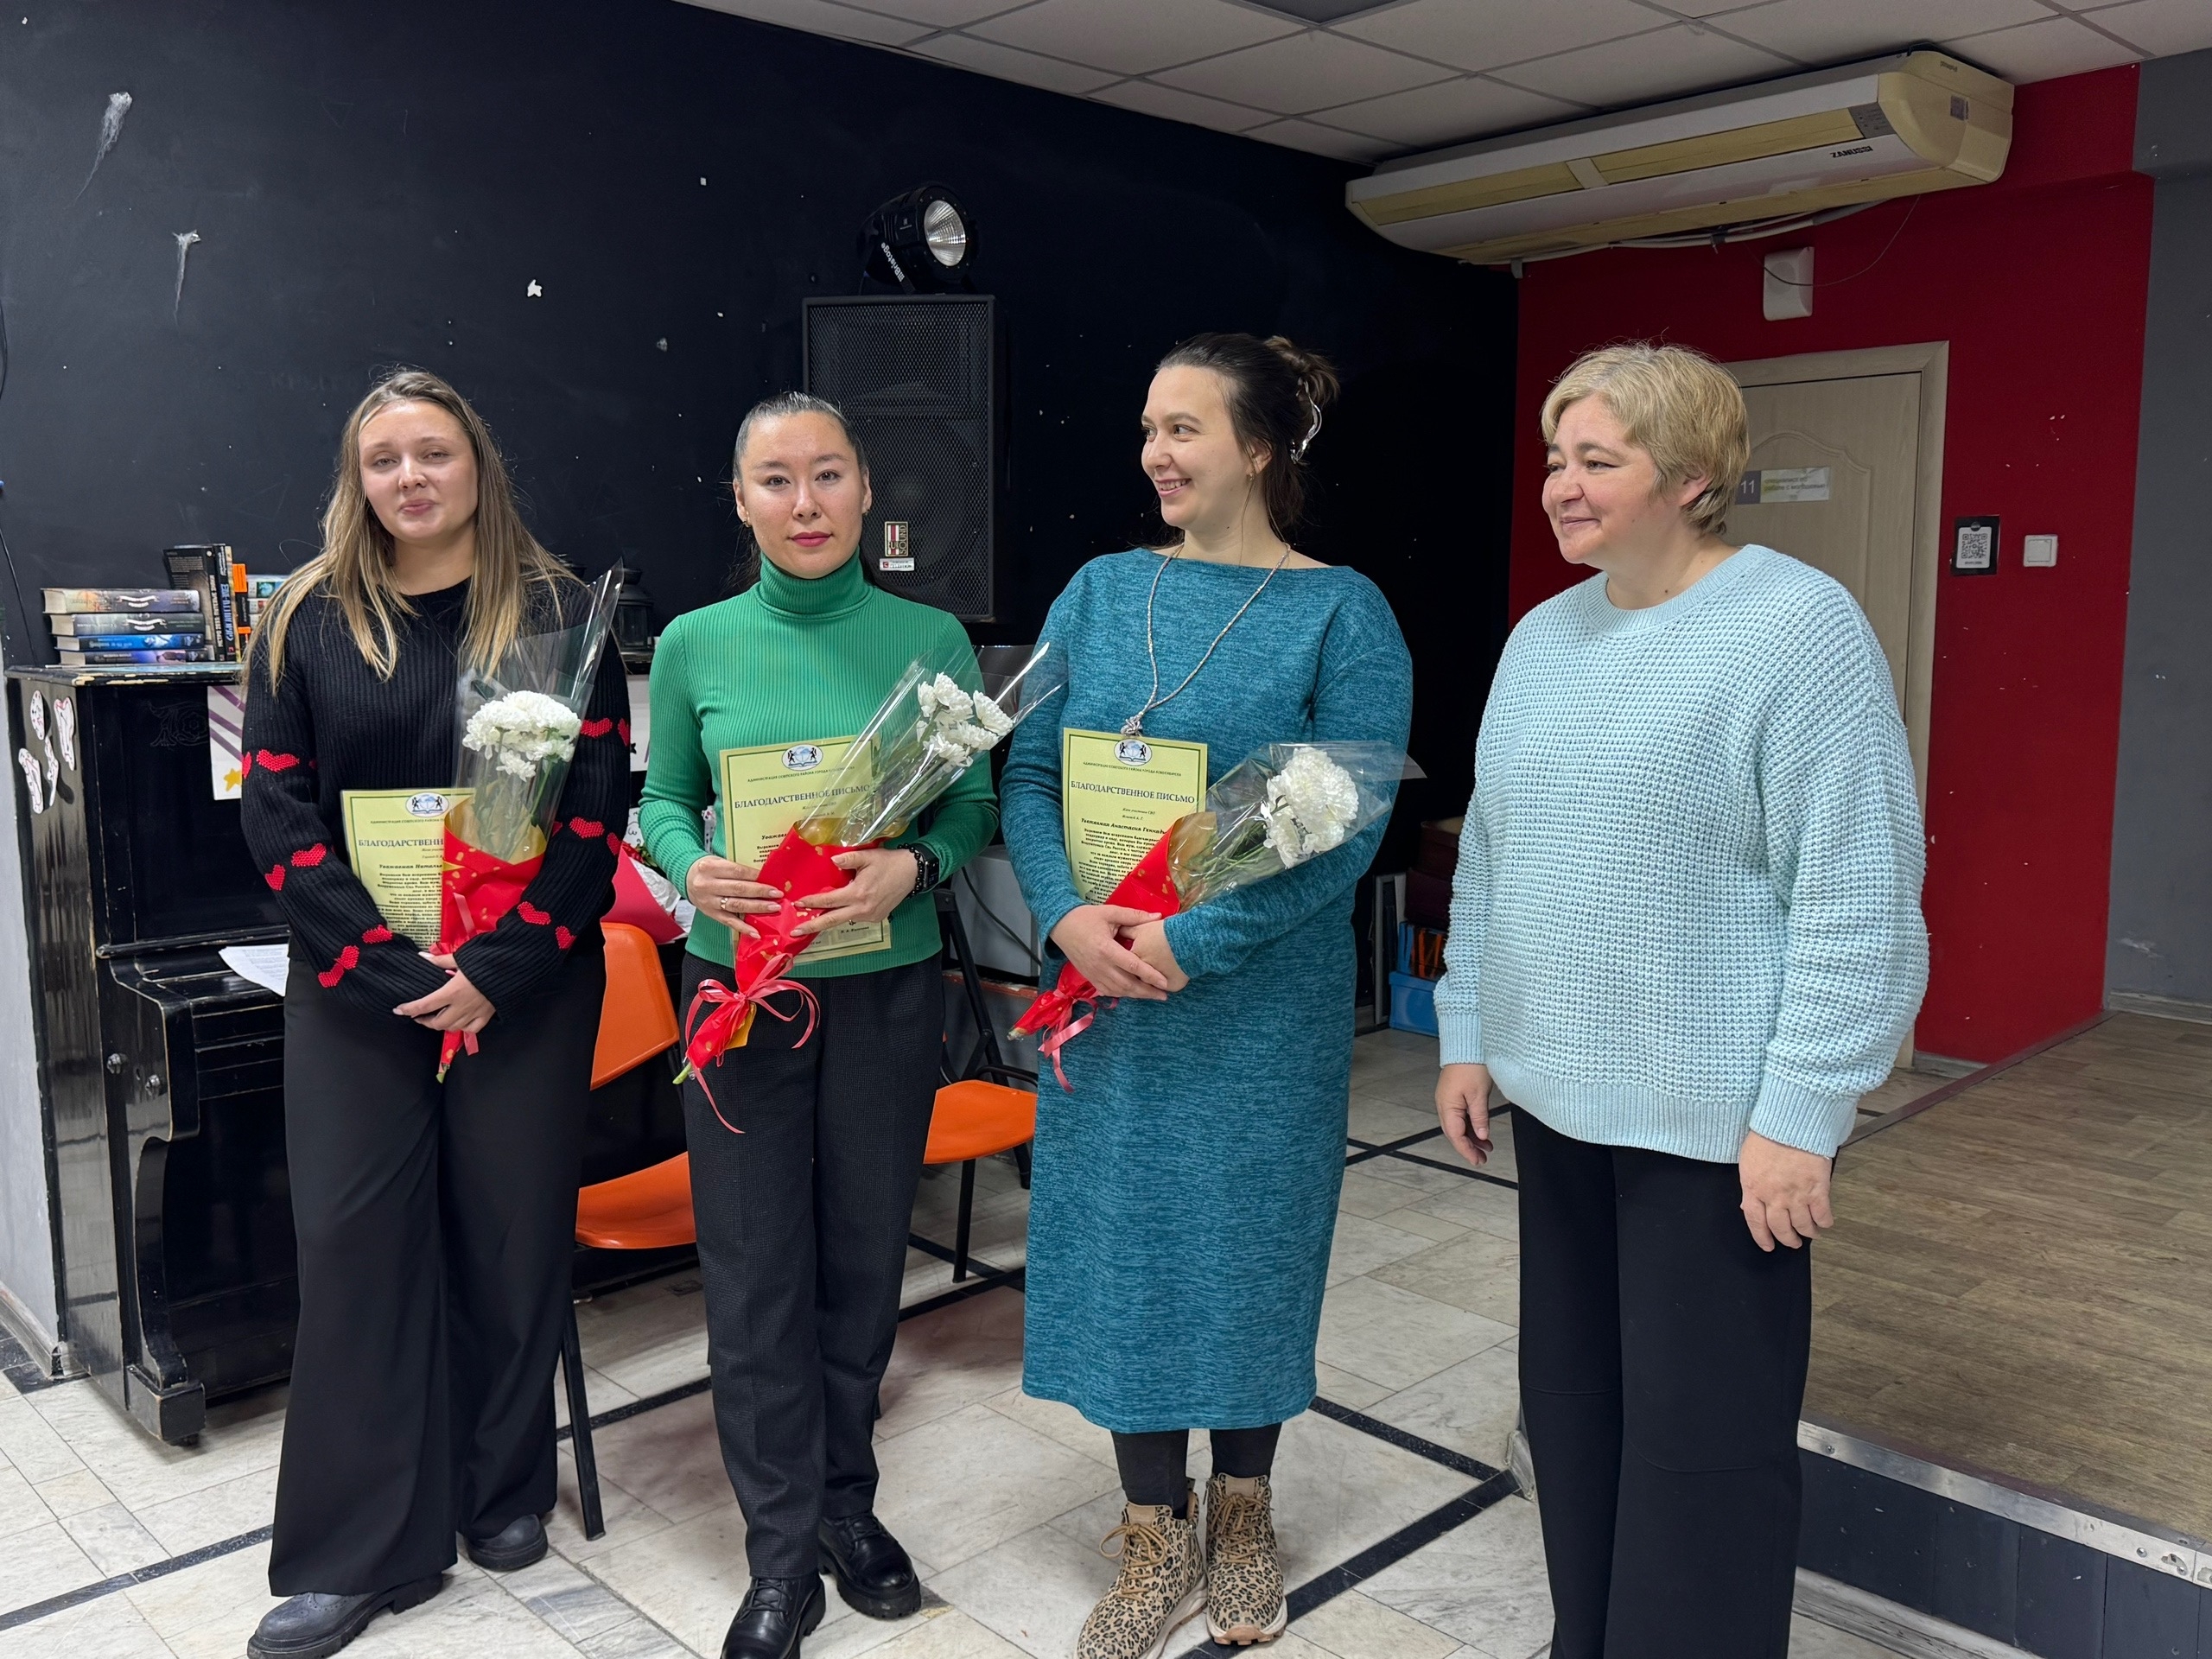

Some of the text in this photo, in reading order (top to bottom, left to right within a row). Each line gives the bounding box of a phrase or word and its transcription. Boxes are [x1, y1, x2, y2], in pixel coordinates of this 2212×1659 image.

[1830, 146, 1873, 158] ZANUSSI
[880, 242, 901, 276] Bristage
[1740, 480, 1755, 494] 11
[734, 789, 830, 809] БЛАГОДАРСТВЕННОЕ
[831, 785, 870, 797] ПИСЬМО
[1071, 780, 1195, 804] БЛАГОДАРСТВЕННОЕ ПИСЬМО
[359, 838, 443, 848] БЛАГОДАРСТВЕНН
